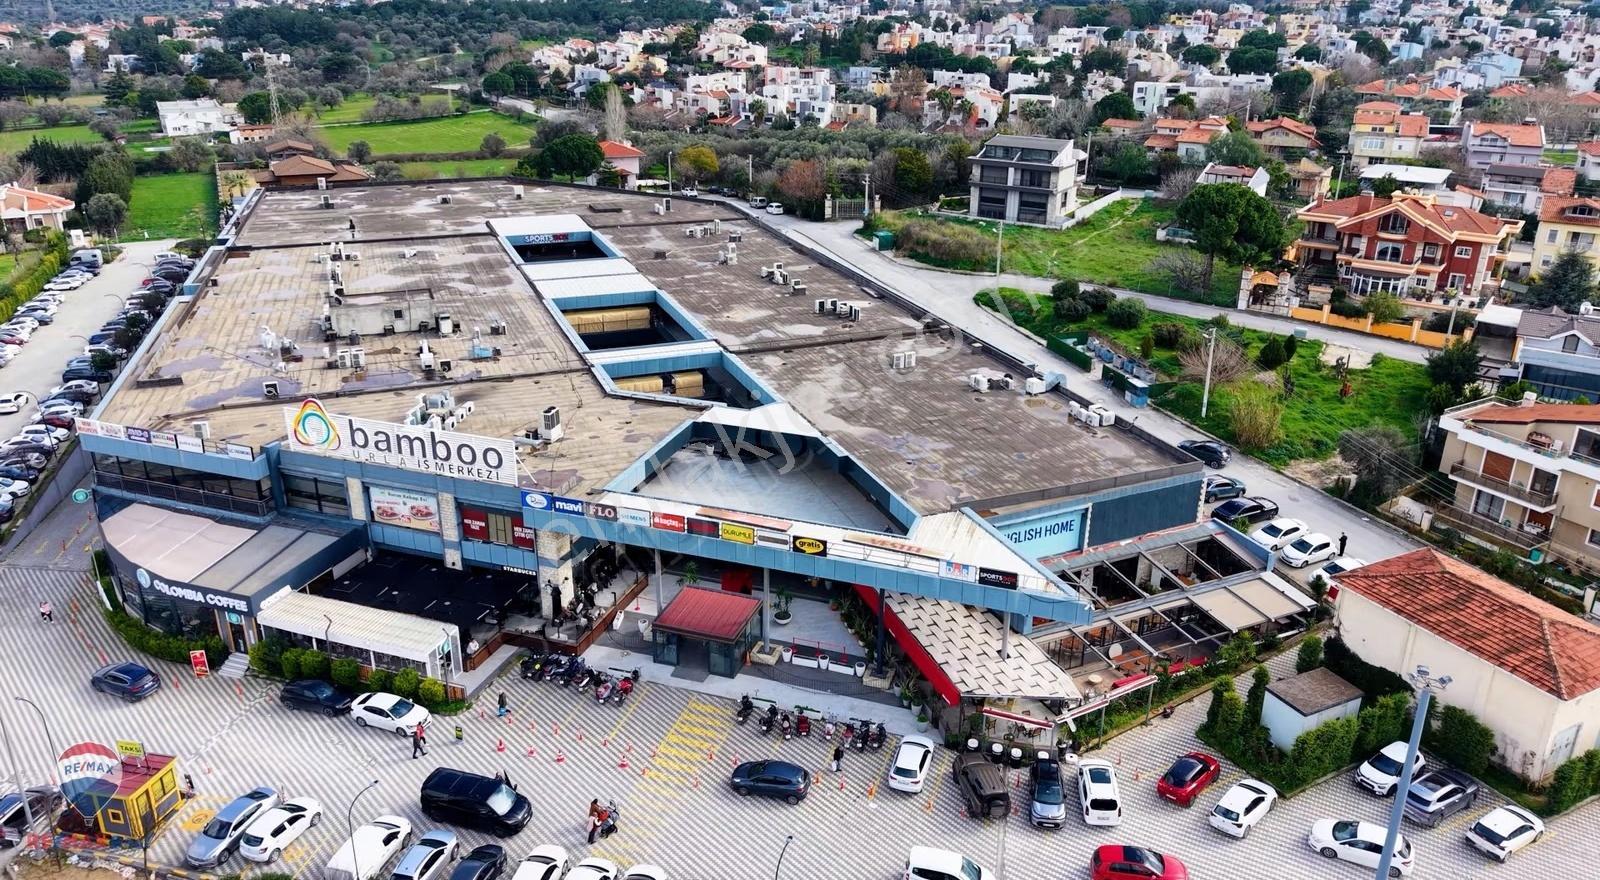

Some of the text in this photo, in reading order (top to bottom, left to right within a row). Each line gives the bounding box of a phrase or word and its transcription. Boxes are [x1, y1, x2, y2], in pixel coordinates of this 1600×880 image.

[349, 419, 503, 470] bamboo
[353, 450, 407, 467] URLA
[555, 501, 582, 512] mavi
[589, 505, 614, 518] FLO
[1004, 520, 1075, 543] GLISH HOME
[798, 539, 821, 549] gratis
[503, 566, 536, 576] STARBUCKS
[153, 579, 249, 612] COLOMBIA COFFEE
